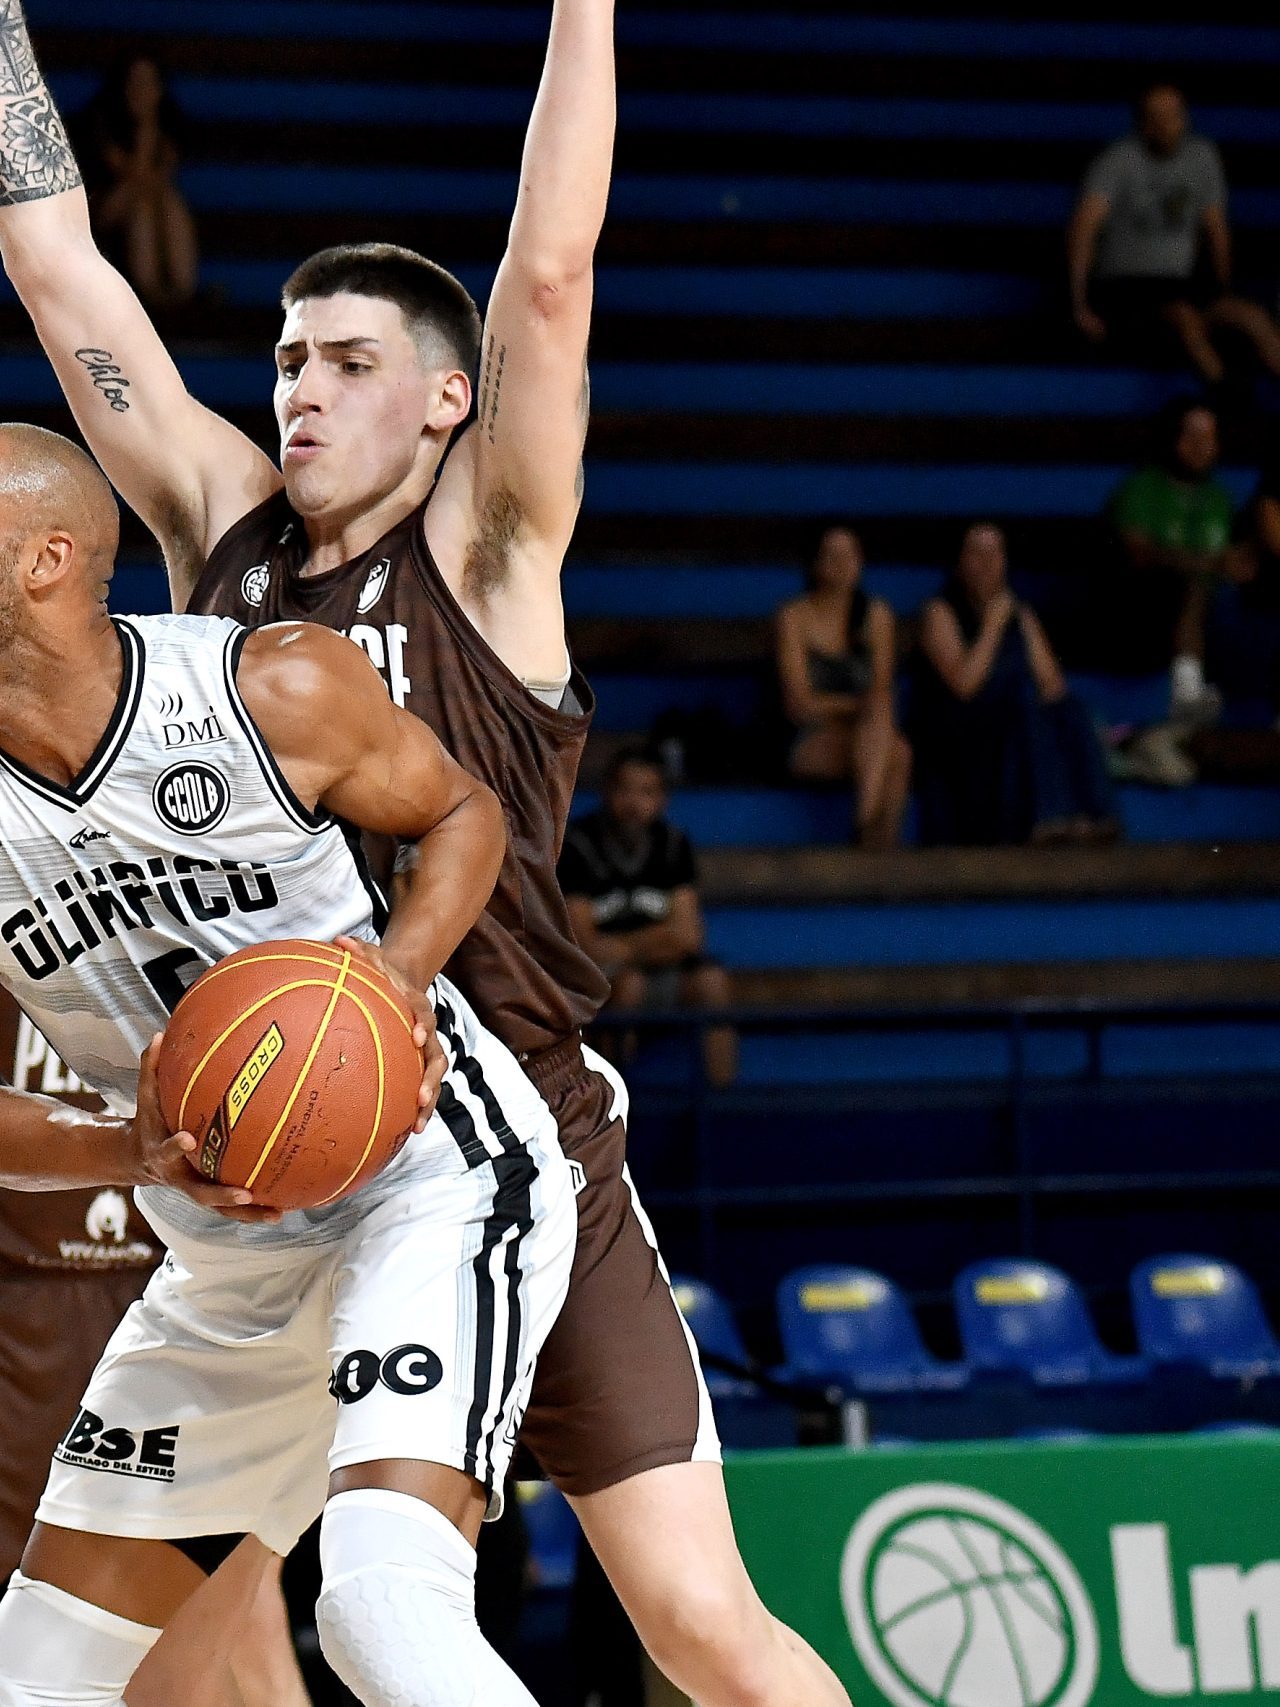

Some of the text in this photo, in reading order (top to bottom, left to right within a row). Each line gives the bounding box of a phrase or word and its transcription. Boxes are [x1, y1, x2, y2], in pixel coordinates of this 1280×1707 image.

[75, 348, 130, 412] Chloe
[230, 1035, 279, 1109] CROSS
[113, 1461, 132, 1471] DEL
